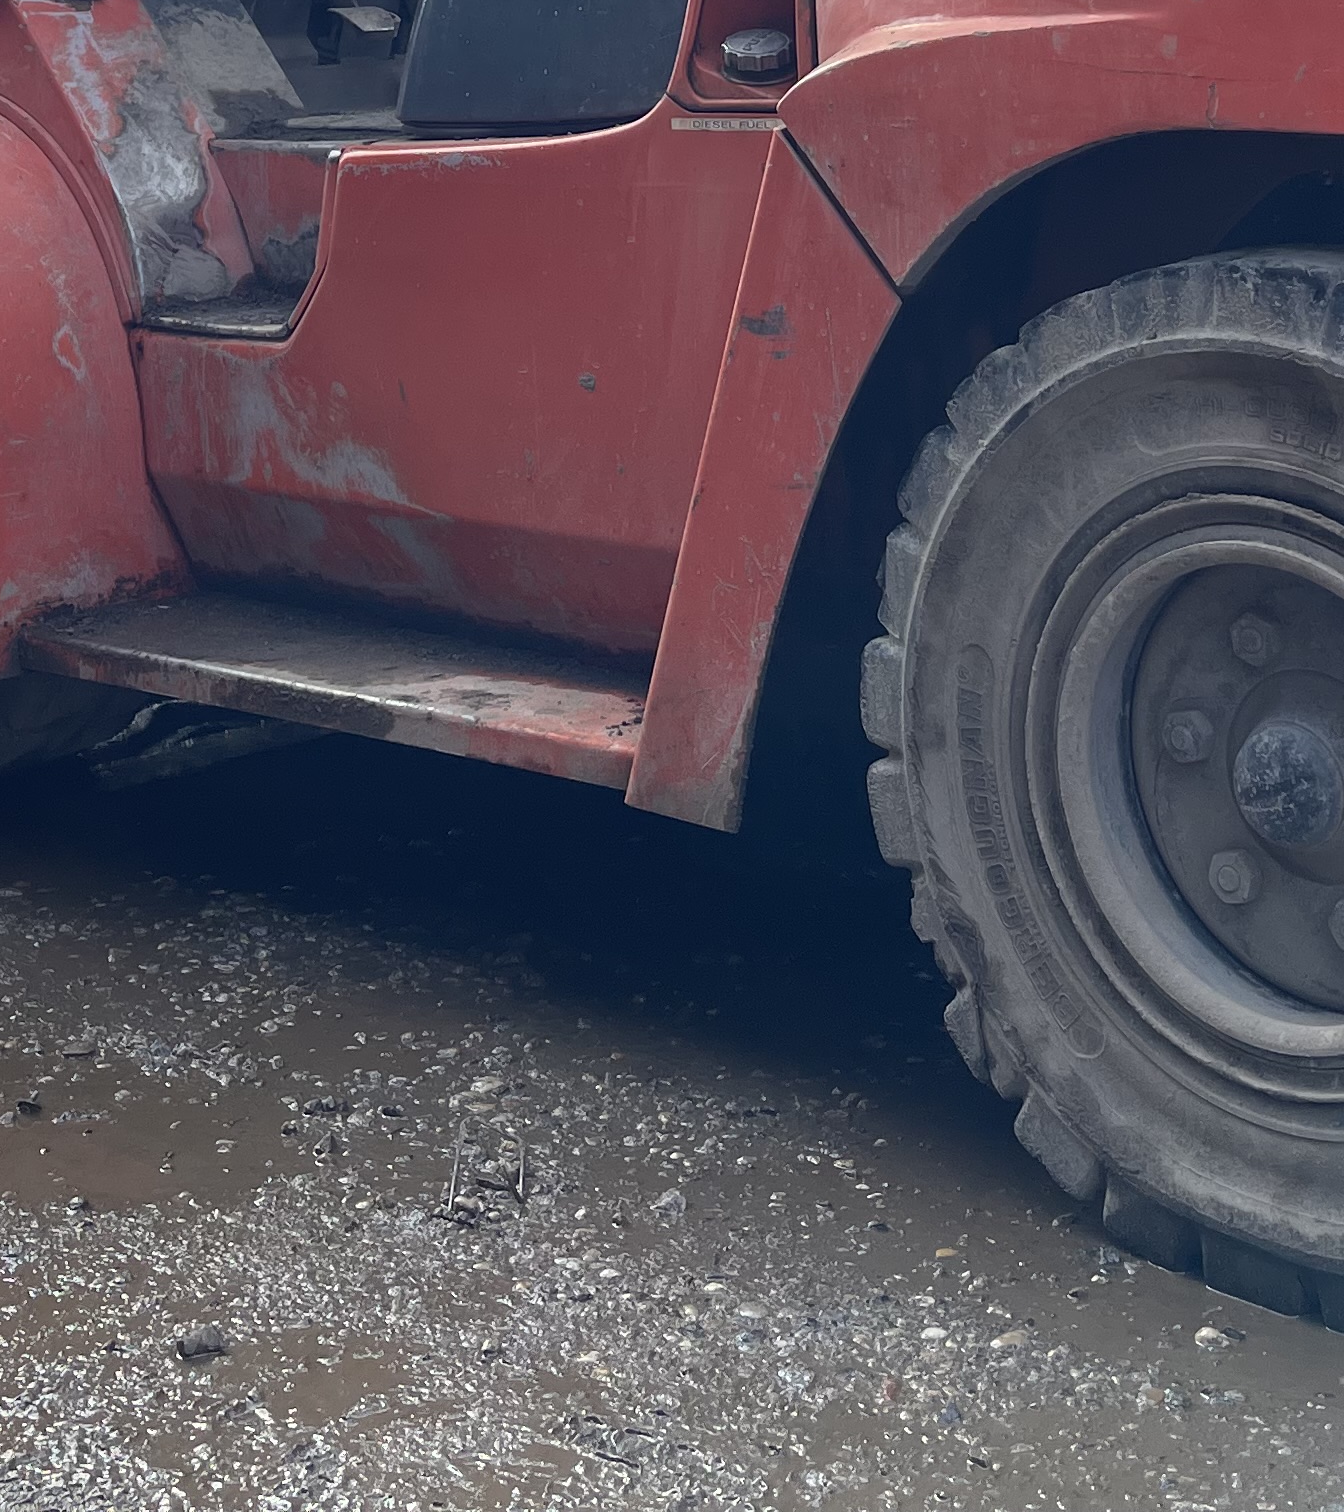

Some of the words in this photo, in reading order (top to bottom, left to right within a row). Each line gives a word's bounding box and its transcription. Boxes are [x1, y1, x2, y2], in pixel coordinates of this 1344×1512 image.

[692, 120, 736, 129] DIESEL
[739, 120, 770, 129] FUEL
[1269, 427, 1342, 462] SOLID
[956, 688, 1081, 1031] BERGOUGNAN
